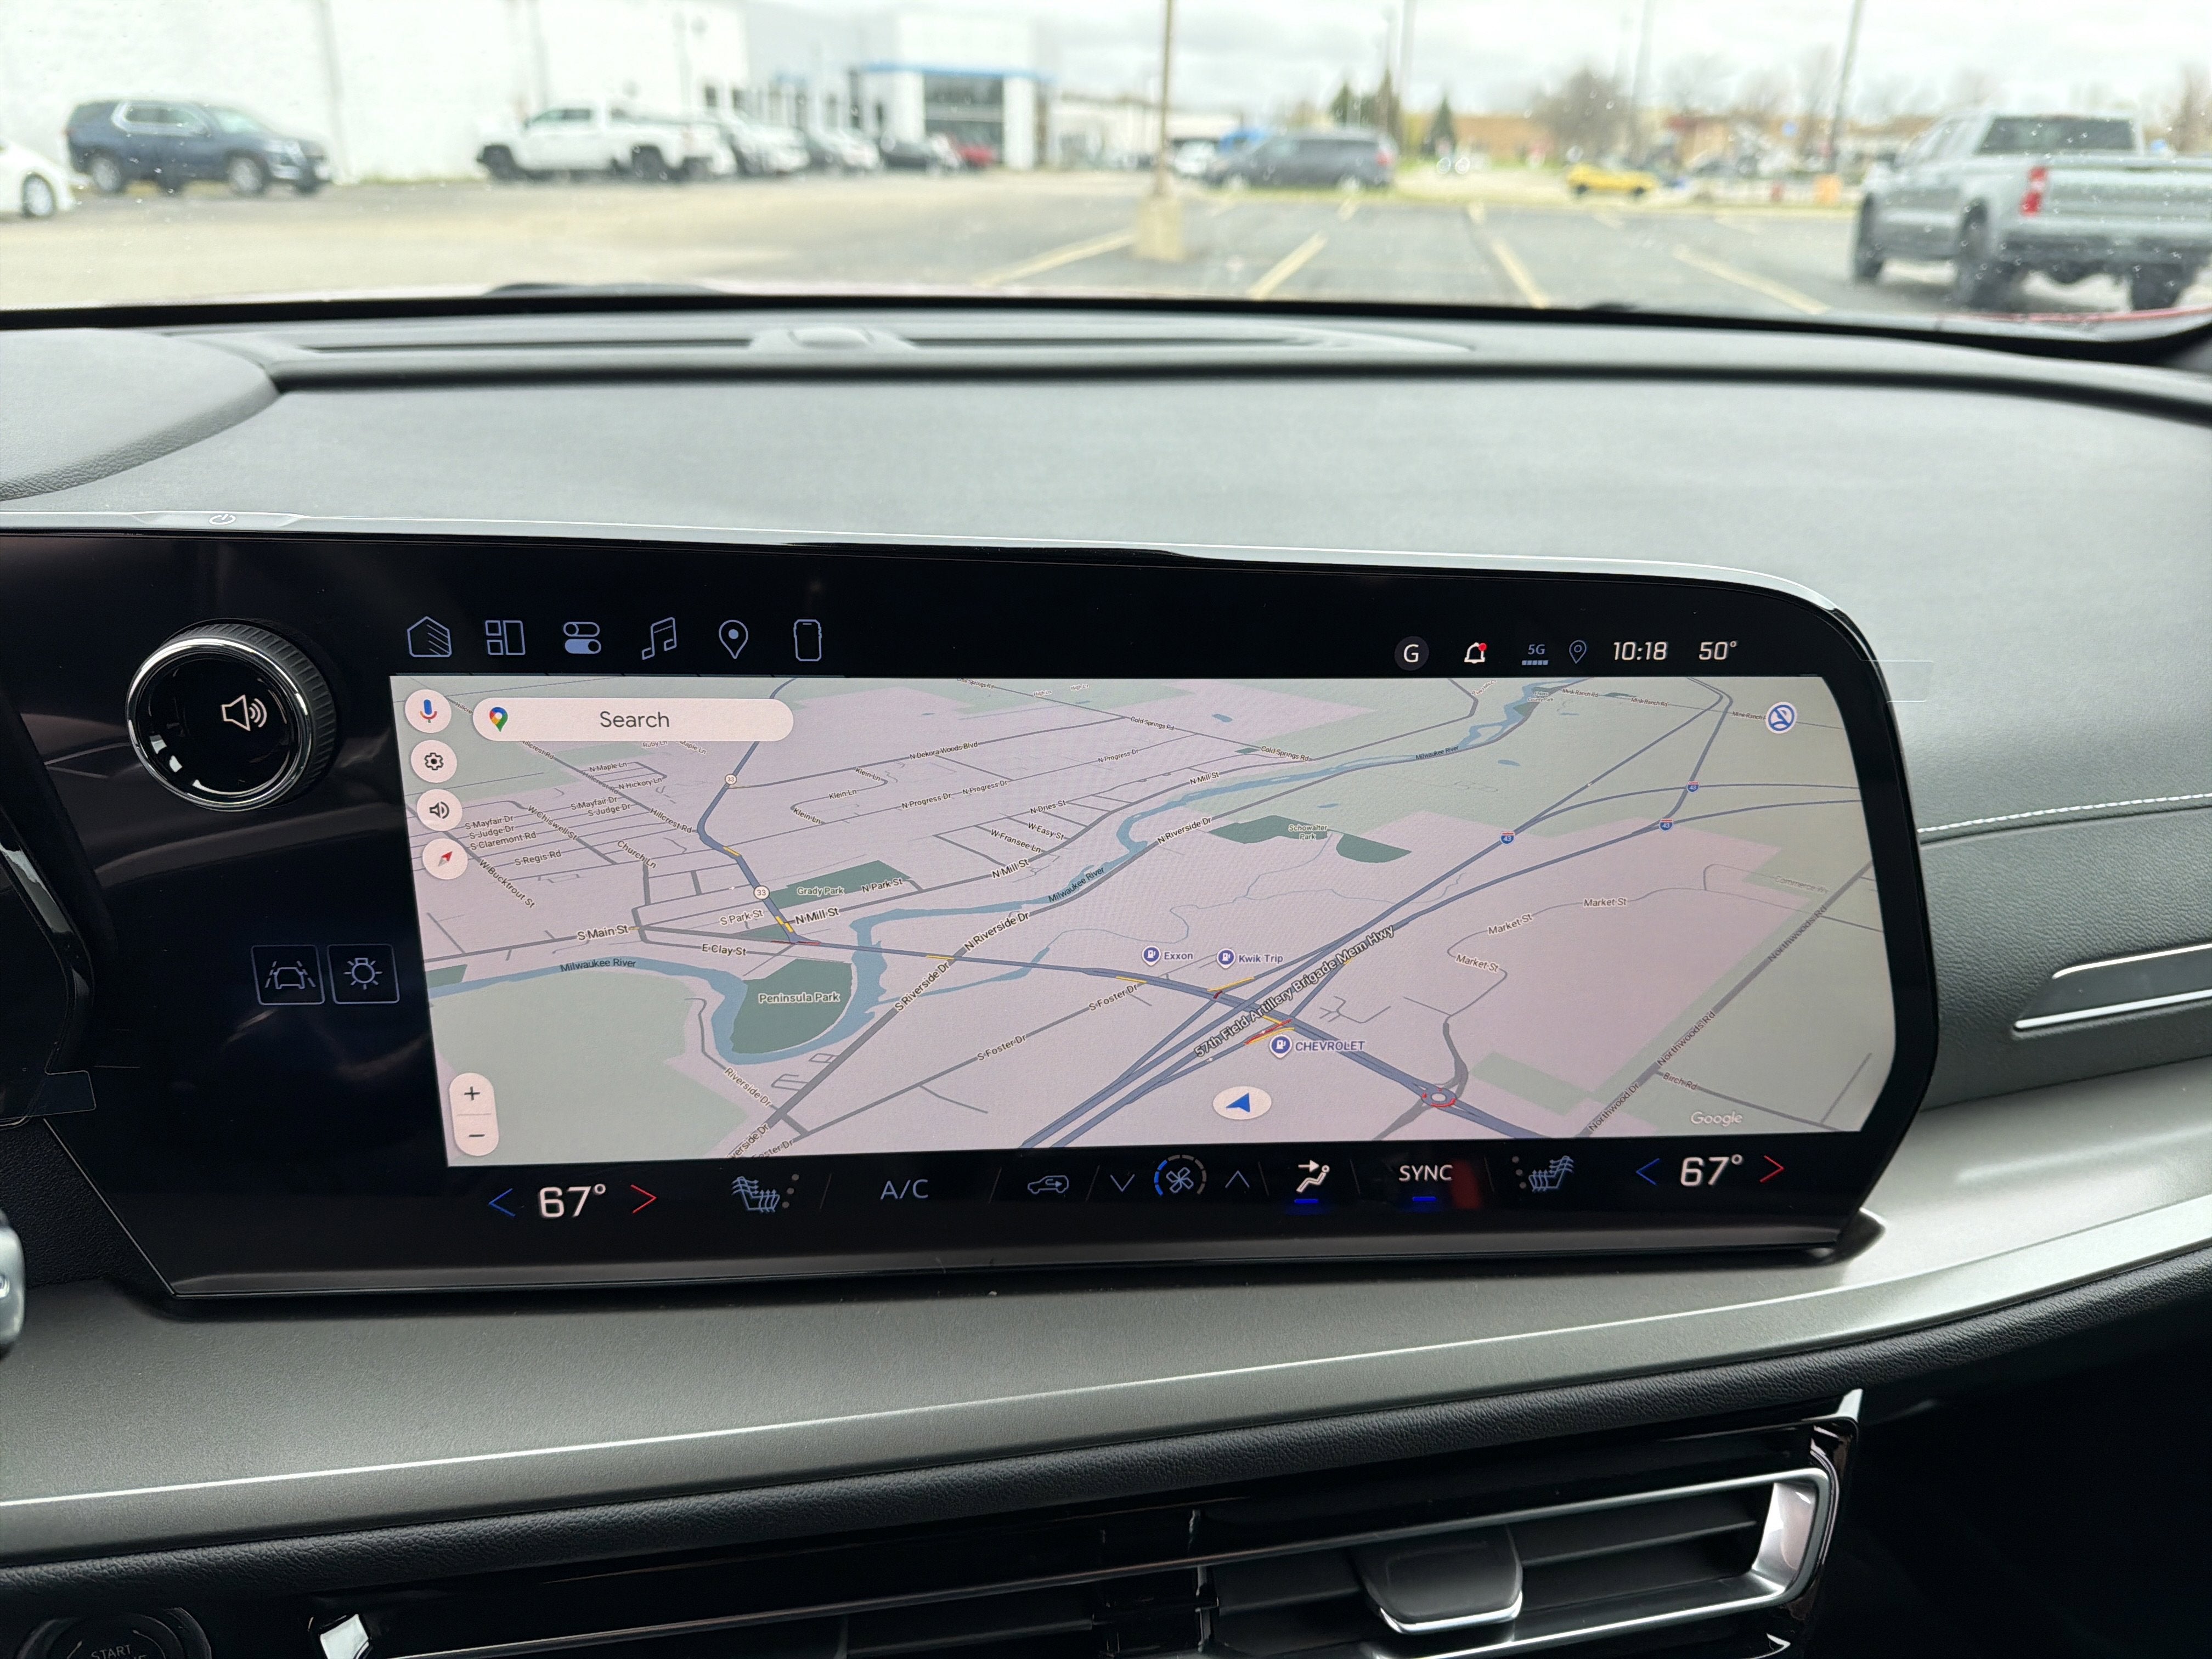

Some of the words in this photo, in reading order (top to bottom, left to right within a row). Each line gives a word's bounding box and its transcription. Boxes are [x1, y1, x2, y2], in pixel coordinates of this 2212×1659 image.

[1404, 644, 1419, 663] G
[1528, 644, 1545, 655] 5G
[1613, 641, 1668, 660] 10:18
[1699, 640, 1738, 660] 50°
[600, 711, 670, 727] Search
[545, 752, 554, 760] Rd
[917, 749, 939, 759] Dekora
[940, 745, 962, 754] Woods
[1276, 749, 1299, 760] Springs
[1415, 748, 1444, 760] Milwaukee
[1445, 746, 1459, 754] River
[626, 780, 651, 789] Hickory
[829, 791, 845, 799] Klein
[910, 795, 941, 809] Progress
[578, 799, 606, 810] Mayfair
[595, 805, 618, 816] Judge
[1037, 803, 1056, 812] Dries
[650, 808, 680, 830] Hillcrest
[681, 823, 692, 833] Rd
[794, 808, 811, 821] Klein
[472, 817, 502, 829] Mayfair
[528, 805, 537, 815] W
[537, 812, 568, 836] Chiswell
[568, 831, 577, 840] St
[476, 828, 501, 839] Judge
[1036, 825, 1054, 838] Easy
[1157, 836, 1166, 844] N
[1166, 821, 1201, 840] Riverside
[1201, 817, 1212, 825] Dr
[478, 834, 523, 849] Claremont
[1000, 832, 1030, 849] Fransee
[522, 854, 548, 865] Regis
[549, 850, 561, 858] Rd
[617, 840, 646, 862] Church
[646, 857, 657, 868] Ln
[992, 871, 1000, 879] N
[1001, 864, 1017, 876] Mill
[1019, 859, 1029, 867] St
[479, 859, 489, 870] W
[488, 867, 525, 901] Bucktrout
[525, 898, 535, 908] St
[872, 881, 890, 891] Park
[1048, 878, 1086, 902] Milwaukee
[1085, 867, 1104, 881] River
[798, 887, 822, 896] Grady
[1584, 898, 1615, 907] Market
[1618, 898, 1627, 906] St
[730, 913, 750, 923] Park
[795, 916, 804, 924] N
[805, 910, 825, 922] Mill
[827, 907, 839, 916] St
[964, 941, 974, 951] N
[973, 918, 1017, 945] Riverside
[1018, 912, 1030, 922] Dr
[1488, 918, 1521, 935] Market
[1522, 913, 1532, 923] St
[578, 932, 585, 940] S
[587, 928, 615, 940] Main
[617, 925, 629, 934] St
[1768, 914, 1816, 962] Northwoods
[1814, 905, 1827, 918] Rd
[712, 945, 732, 956] Clay
[735, 947, 746, 956] St
[560, 958, 611, 972] Milwaukee
[613, 958, 636, 968] River
[1239, 955, 1261, 963] Kwik
[1265, 955, 1283, 964] Trip
[1456, 954, 1488, 969] Market
[1488, 963, 1499, 972] St
[895, 1002, 903, 1012] S
[902, 973, 940, 1006] Riverside
[937, 961, 950, 974] Dr
[1194, 1034, 1222, 1057] 57th
[1221, 1017, 1250, 1041] Field
[1250, 988, 1294, 1023] Artillery
[1292, 959, 1336, 994] Brigade
[1336, 942, 1368, 964] Mem
[1367, 925, 1395, 946] Hwy
[760, 994, 811, 1003] Peninsula
[816, 992, 839, 1001] Park
[1089, 1003, 1096, 1011] S
[1097, 991, 1126, 1008] Foster
[1127, 983, 1138, 993] Dr
[986, 1040, 1014, 1057] Foster
[1015, 1034, 1026, 1043] Dr
[1657, 1023, 1704, 1065] Northwoods
[1702, 1011, 1716, 1024] Rd
[1296, 1041, 1365, 1051] CHEVROLET
[725, 1068, 760, 1098] Riverside
[759, 1095, 772, 1107] Dr
[1663, 1073, 1684, 1085] Birch
[1685, 1081, 1697, 1090] Rd
[1588, 1091, 1630, 1131] Northwood
[1628, 1082, 1640, 1094] Dr
[1691, 1111, 1743, 1127] Google
[757, 1123, 769, 1135] Dr
[782, 1139, 793, 1149] Dr
[1398, 1165, 1453, 1182] SYNC
[1680, 1154, 1744, 1187] 67°
[881, 1179, 928, 1200] A/C
[539, 1183, 606, 1218] 67°
[91, 1644, 131, 1659] START
